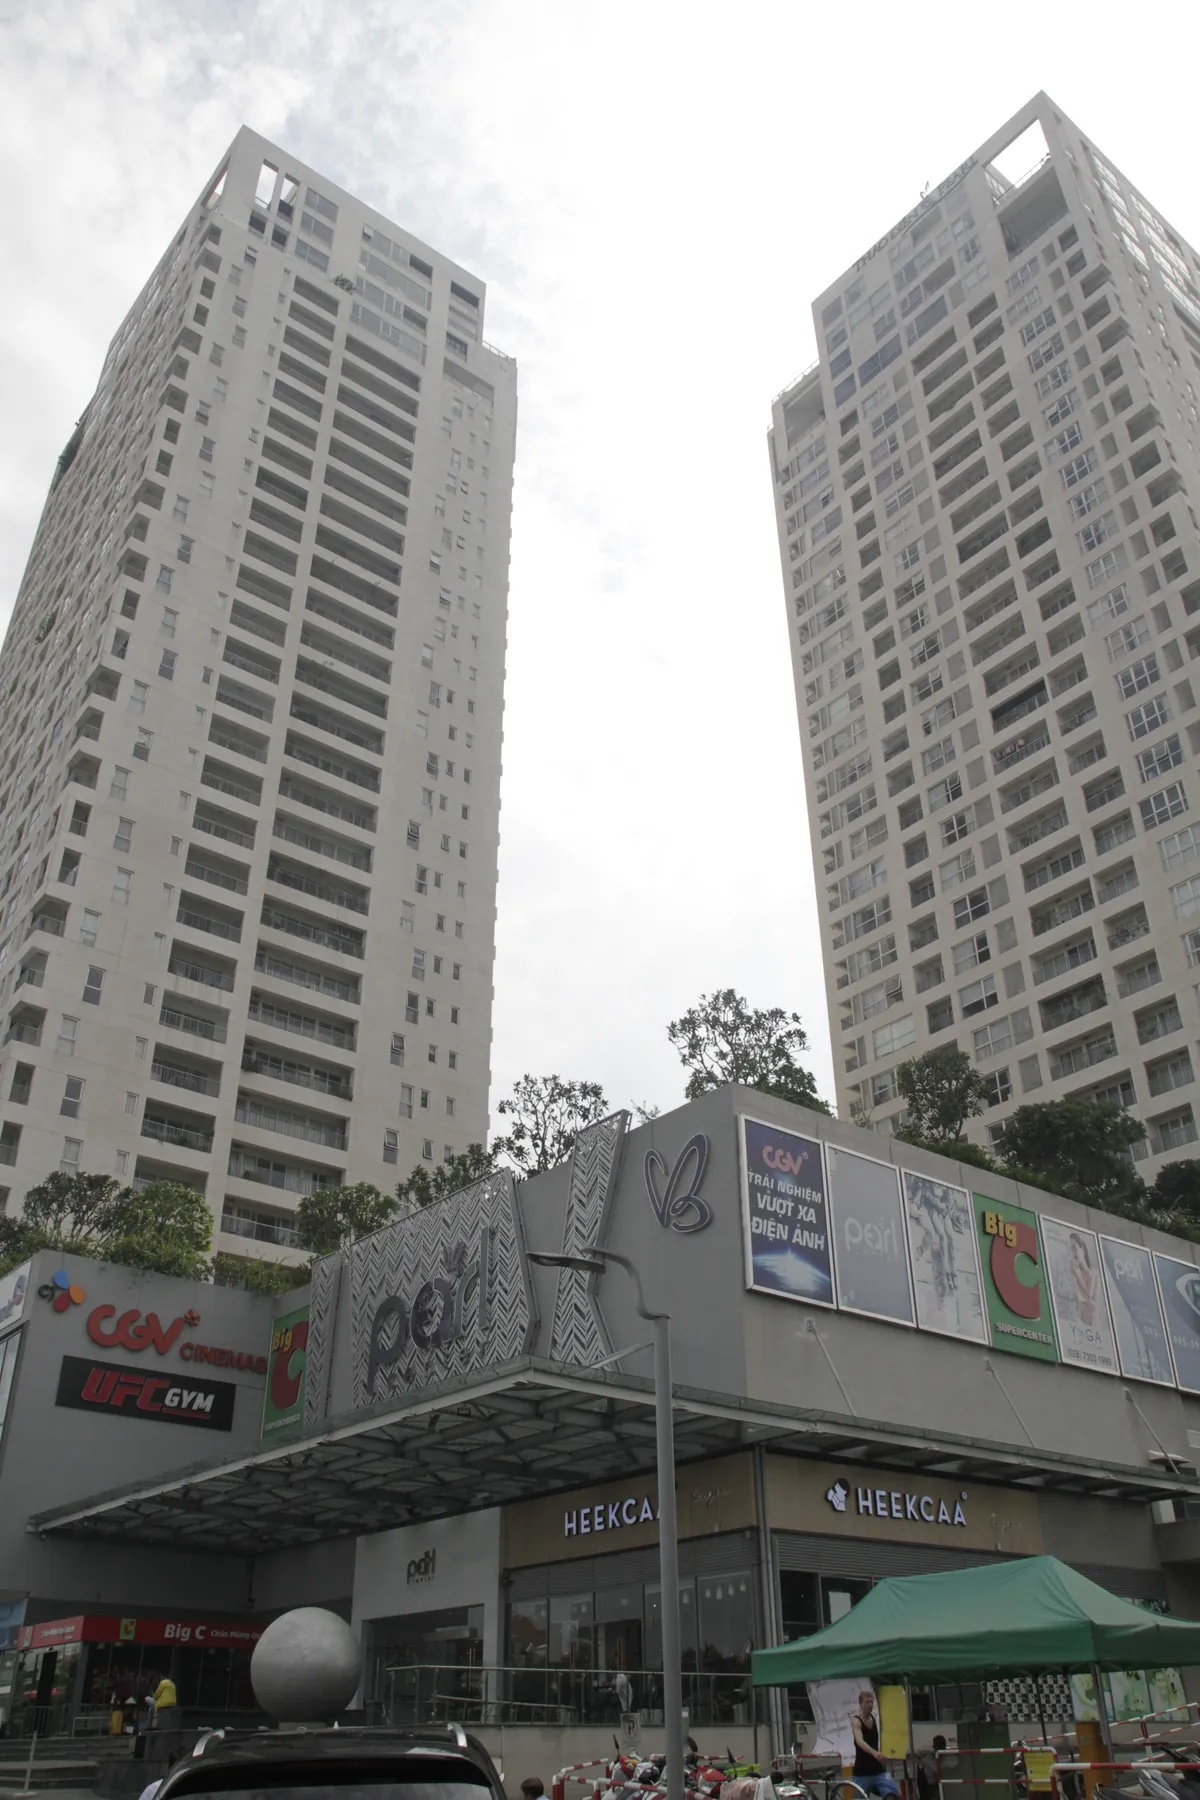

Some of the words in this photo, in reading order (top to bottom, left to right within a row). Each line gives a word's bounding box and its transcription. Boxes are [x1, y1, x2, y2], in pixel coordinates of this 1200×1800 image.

[761, 1144, 804, 1177] CGV
[777, 1181, 823, 1205] NGHIỆM
[798, 1205, 817, 1225] XA
[984, 1210, 1018, 1248] Big
[750, 1216, 789, 1242] ĐIỆN
[791, 1223, 826, 1252] ẢNH
[990, 1220, 1040, 1322] C
[86, 1303, 185, 1355] CGV
[272, 1327, 293, 1354] Big
[996, 1322, 1053, 1346] SUPERCENTER
[179, 1341, 268, 1375] CINEMAS
[270, 1320, 309, 1410] C
[80, 1368, 172, 1413] UFC
[163, 1386, 216, 1413] GYM
[564, 1496, 661, 1537] HEEKCA
[856, 1486, 967, 1527] HEEKCAA
[163, 1623, 192, 1642] Big
[195, 1625, 207, 1640] C
